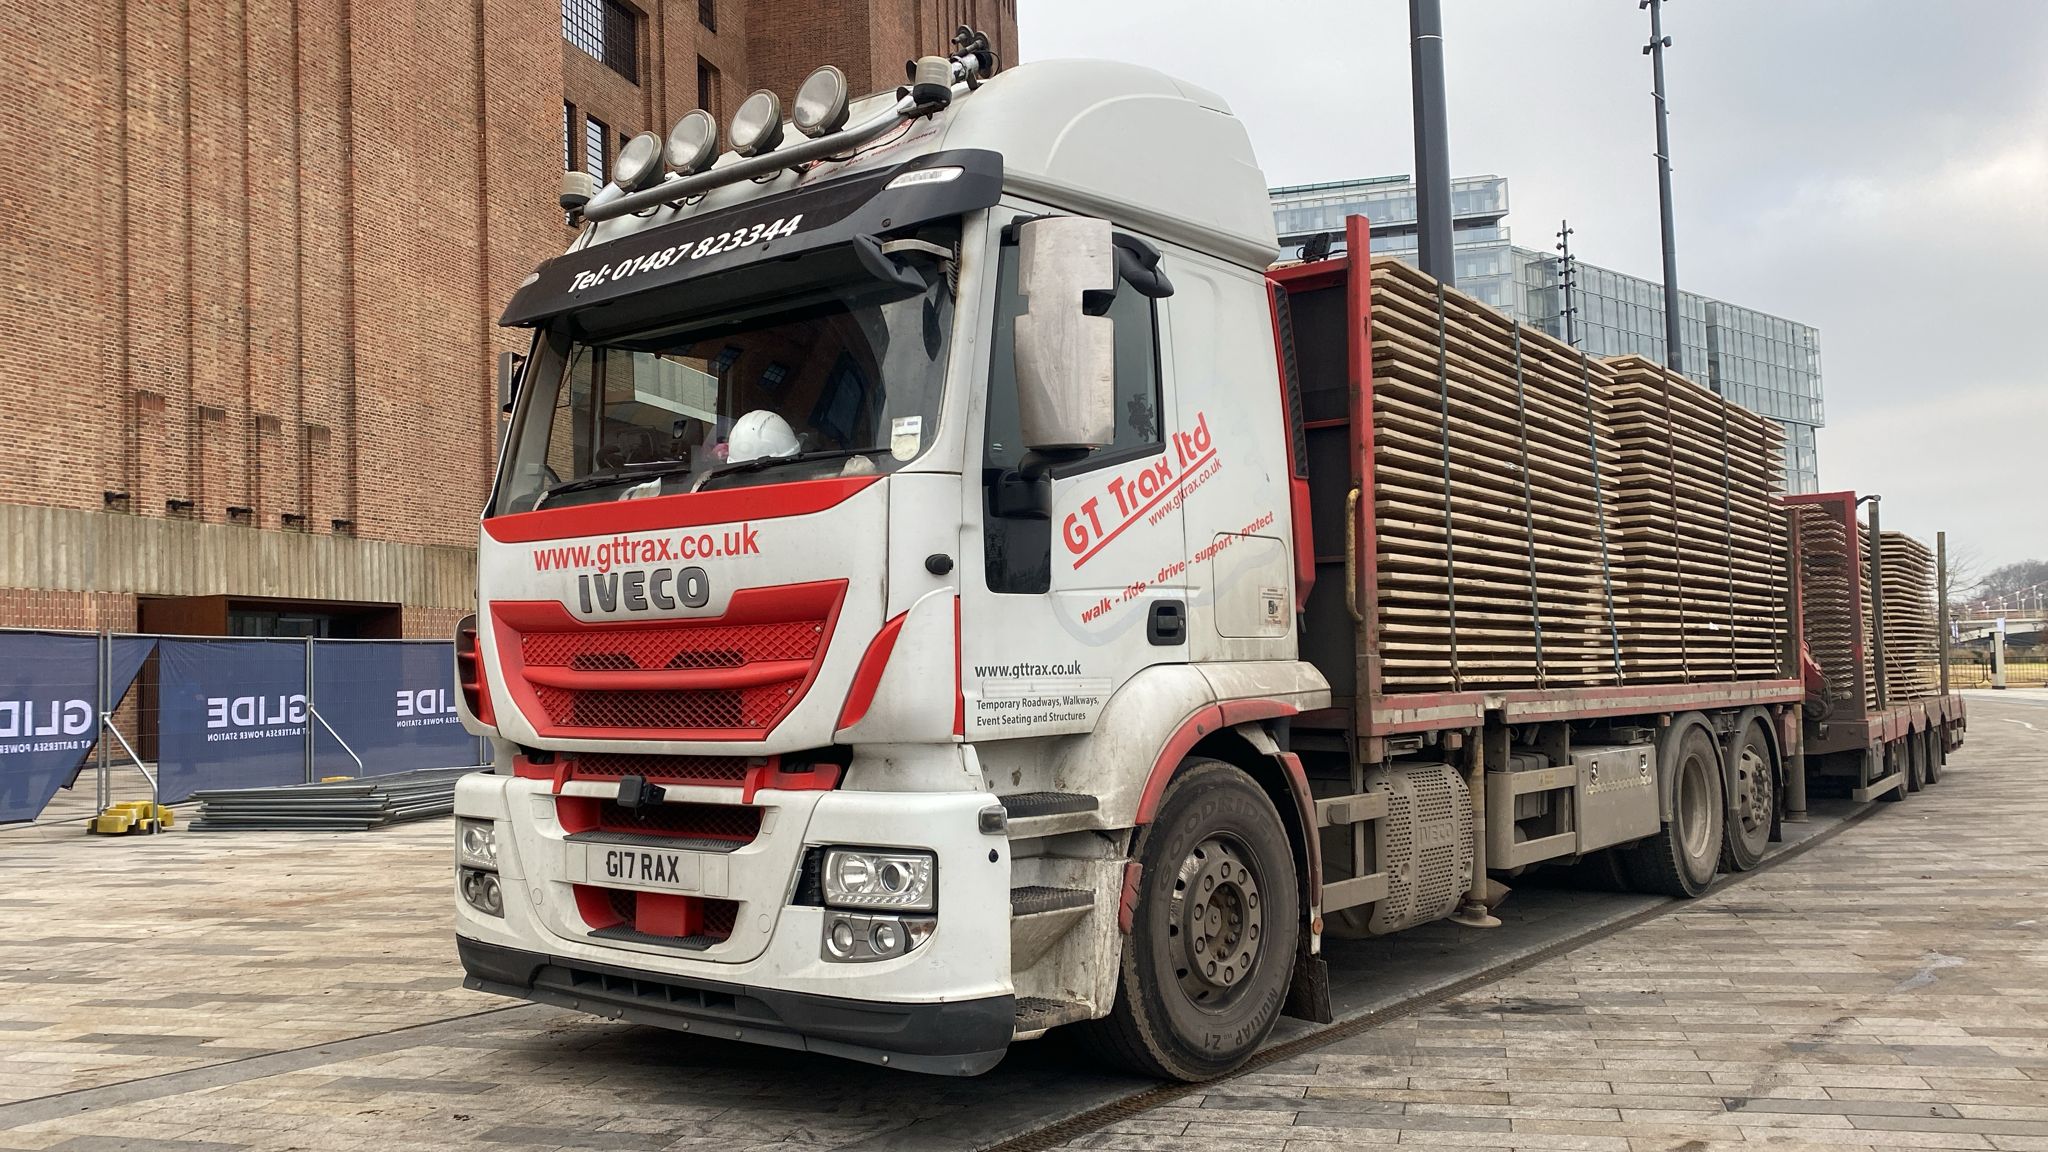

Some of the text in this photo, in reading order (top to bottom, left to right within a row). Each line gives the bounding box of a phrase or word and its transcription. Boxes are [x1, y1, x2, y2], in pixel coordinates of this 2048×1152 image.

[567, 214, 804, 294] Tel: 01487 823344
[1062, 411, 1212, 554] GT Trax ltd
[1148, 457, 1223, 526] www.gttrax.co.uk
[534, 523, 760, 573] www.gttrax.co.uk
[1081, 597, 1112, 624] walk
[1123, 581, 1146, 602] ride
[1157, 560, 1186, 584] drive
[1194, 534, 1233, 563] support
[1241, 511, 1275, 542] protect
[577, 566, 710, 614] IVECO
[975, 660, 1081, 678] www.gttrax.co.uk
[976, 699, 1021, 712] Temporary
[1021, 697, 1062, 708] Roadways,
[976, 711, 1086, 727] Event Seating and Structures
[606, 850, 680, 883] G17 RAX
